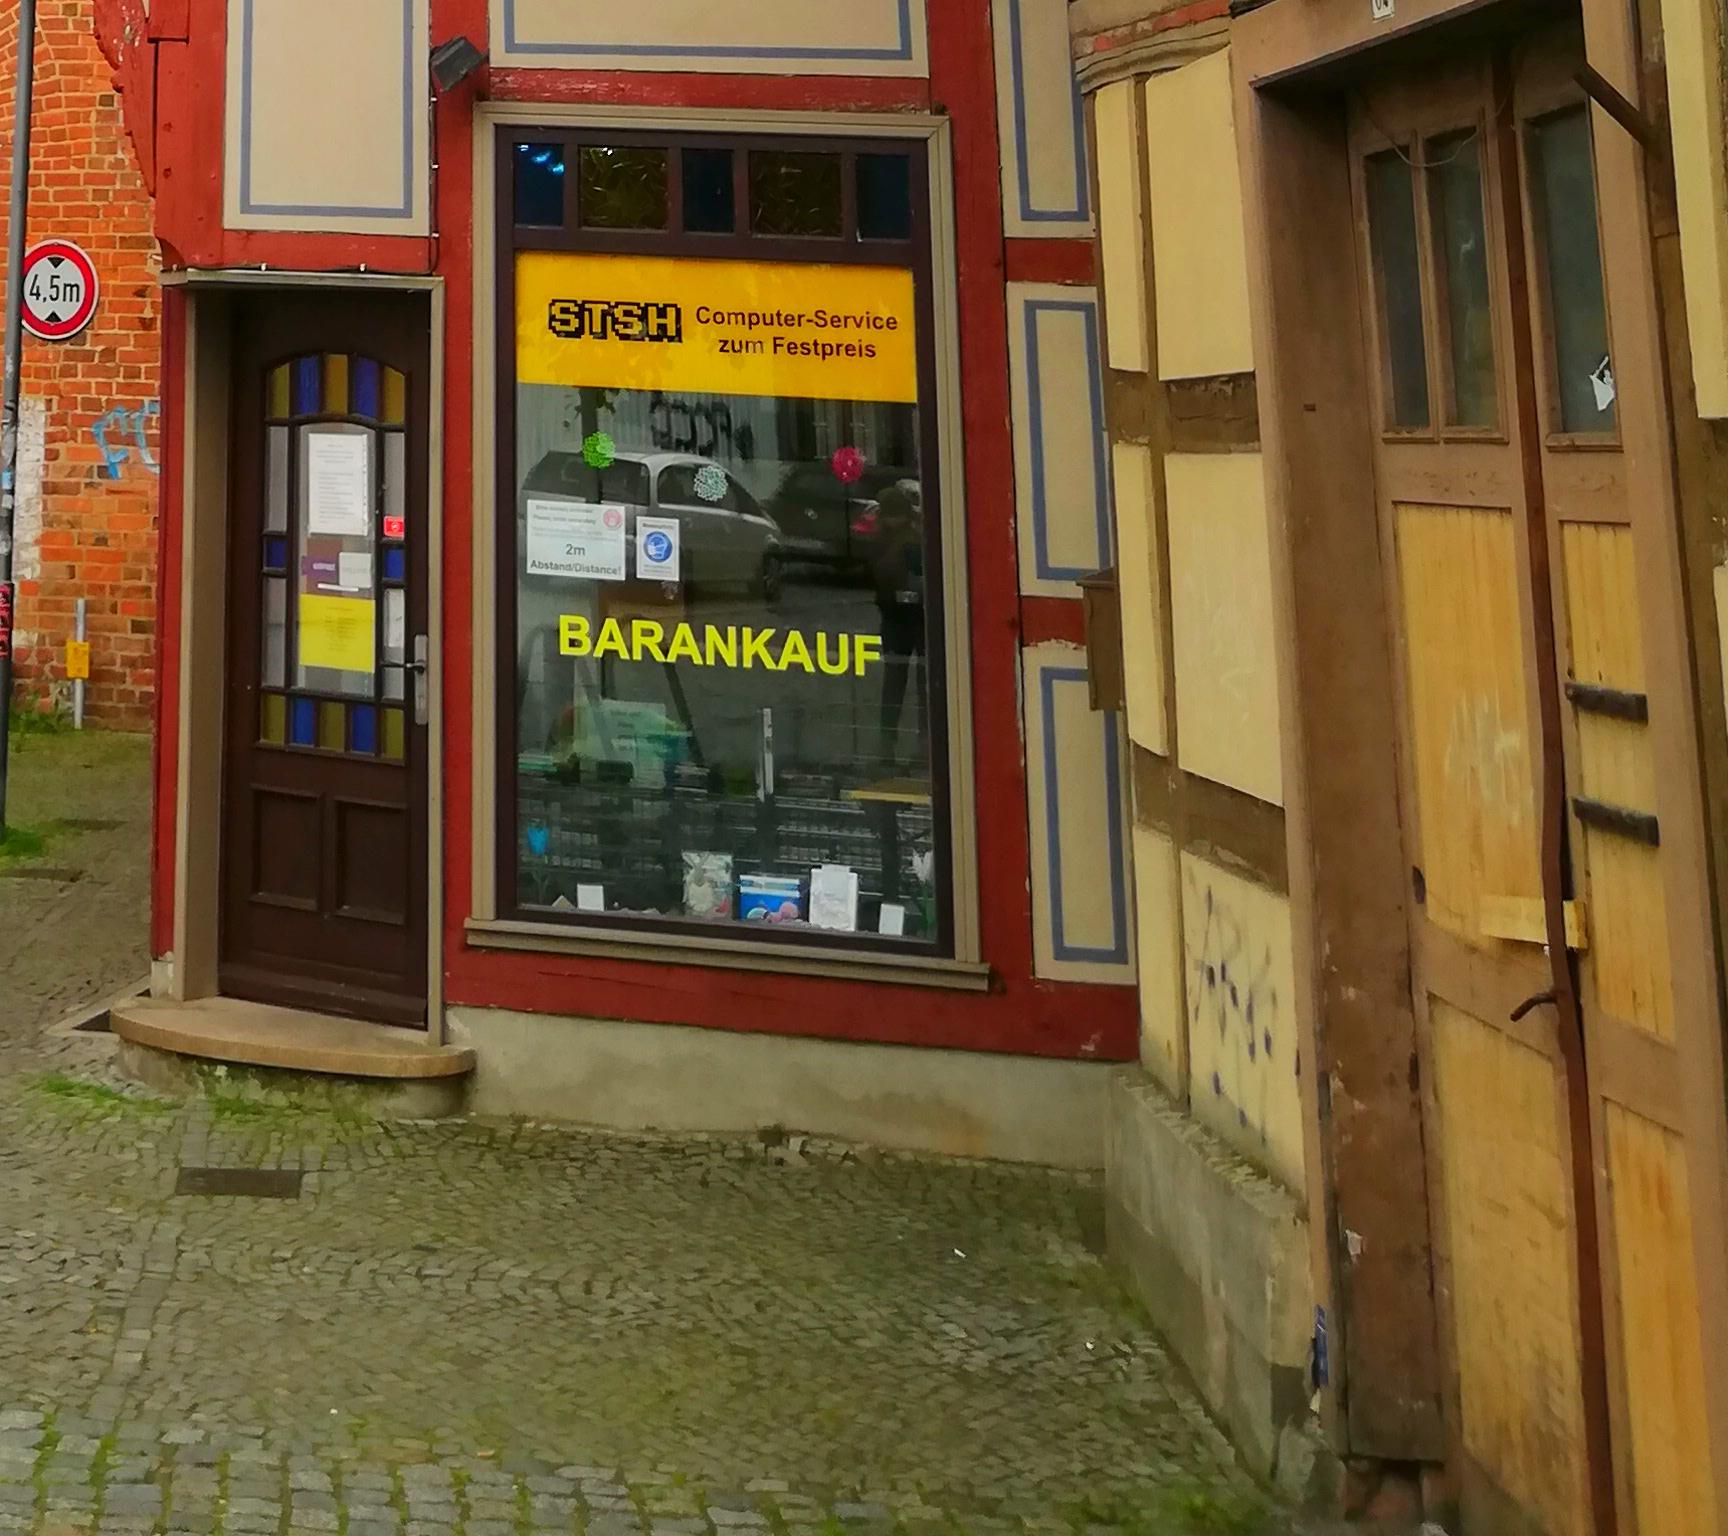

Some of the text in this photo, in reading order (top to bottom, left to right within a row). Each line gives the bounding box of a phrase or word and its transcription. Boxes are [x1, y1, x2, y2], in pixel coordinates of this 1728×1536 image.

[29, 274, 80, 303] 4,5m
[548, 299, 899, 343] STSH Computer-Service
[718, 336, 877, 361] zum Festpreis
[566, 543, 586, 556] 2m
[530, 559, 623, 576] Abstand/Distance!
[559, 614, 883, 676] BARANKAUF
